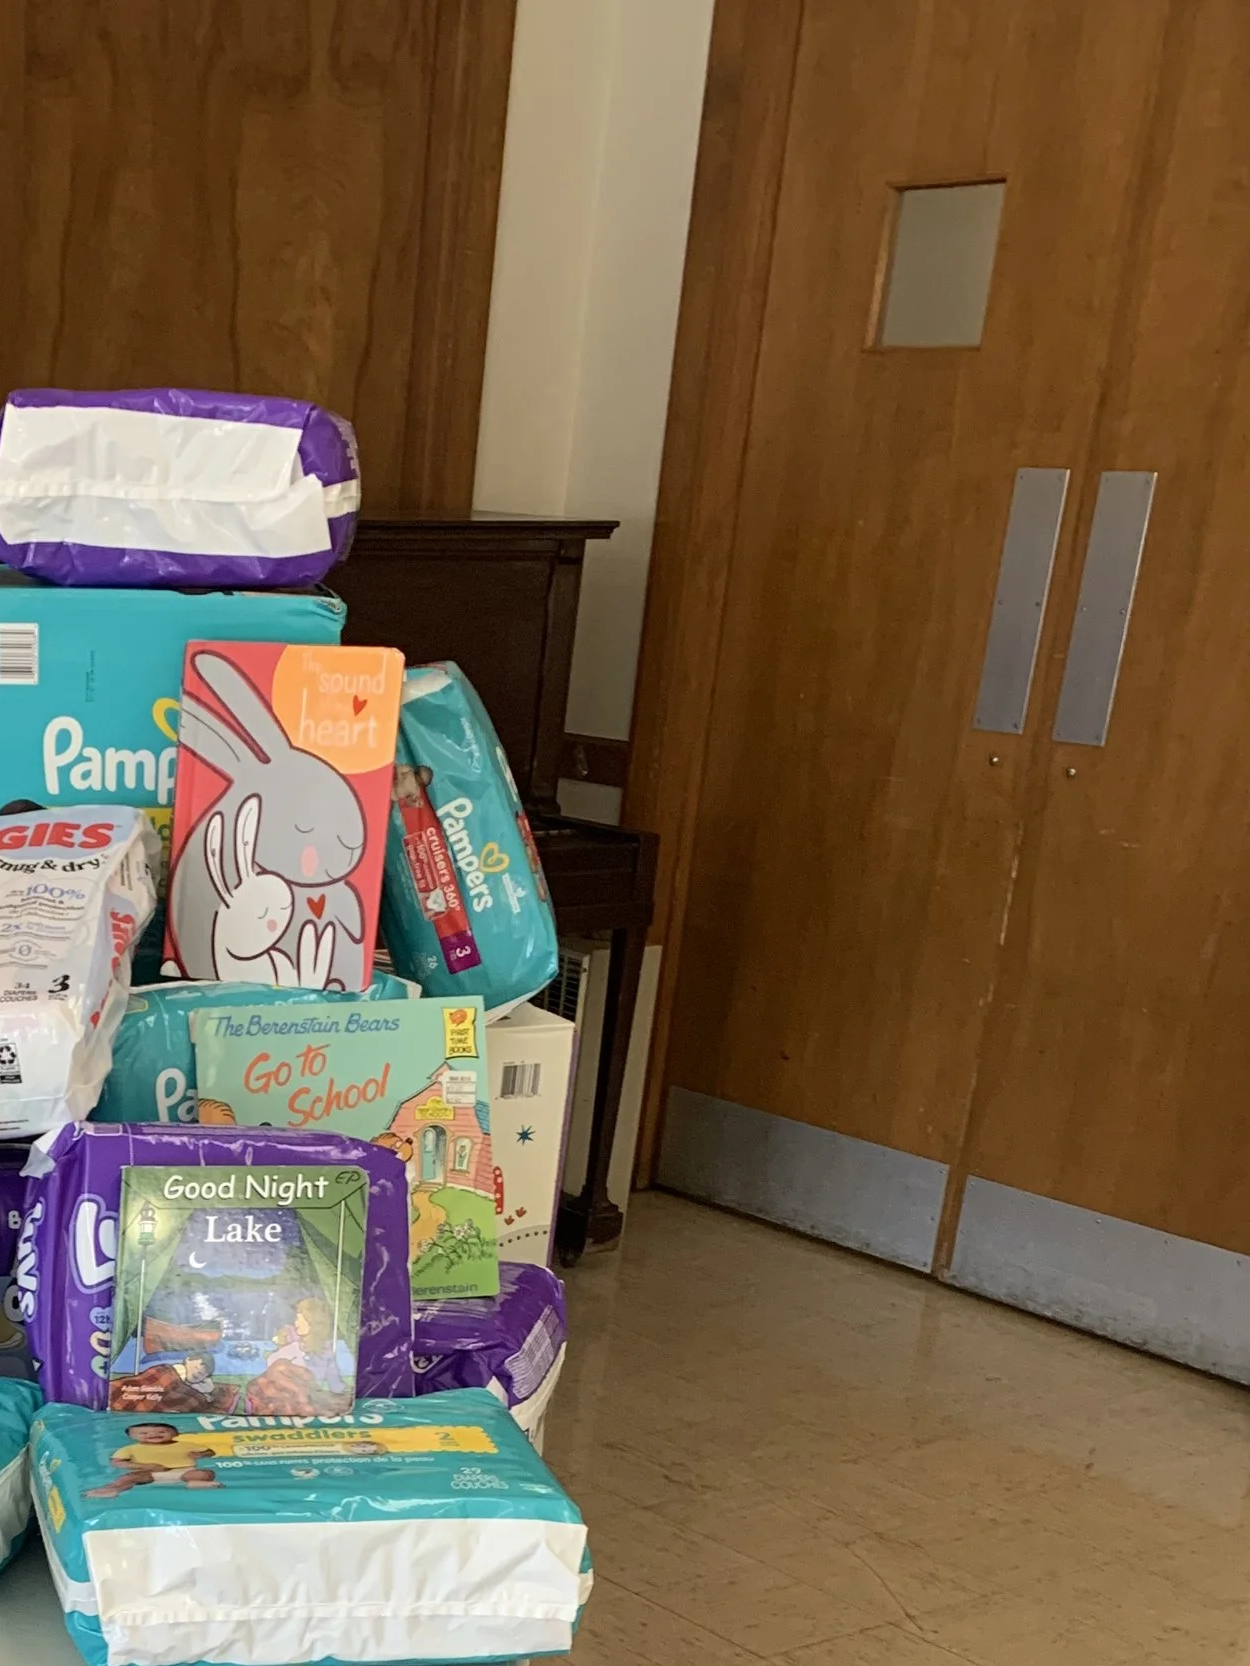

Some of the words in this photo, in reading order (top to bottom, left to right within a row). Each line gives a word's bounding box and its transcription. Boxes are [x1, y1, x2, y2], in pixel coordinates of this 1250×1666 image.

[318, 654, 386, 695] sound
[298, 687, 378, 748] heart
[43, 716, 178, 805] Pamp
[40, 859, 59, 871] &
[426, 827, 451, 883] cruisers
[436, 797, 493, 912] Pampers
[26, 883, 86, 900] 100%
[455, 945, 471, 958] 3
[47, 974, 71, 994] 3
[209, 1015, 244, 1038] The
[244, 1014, 341, 1037] Berenstain
[344, 1012, 400, 1033] Bears
[244, 1052, 292, 1094] Go
[296, 1043, 331, 1077] to
[287, 1062, 391, 1128] School
[164, 1175, 235, 1201] Good
[245, 1173, 330, 1206] Night
[204, 1215, 283, 1243] Lake
[233, 1430, 372, 1443] swaddlers
[435, 1432, 455, 1441] 2
[312, 1457, 372, 1465] protection
